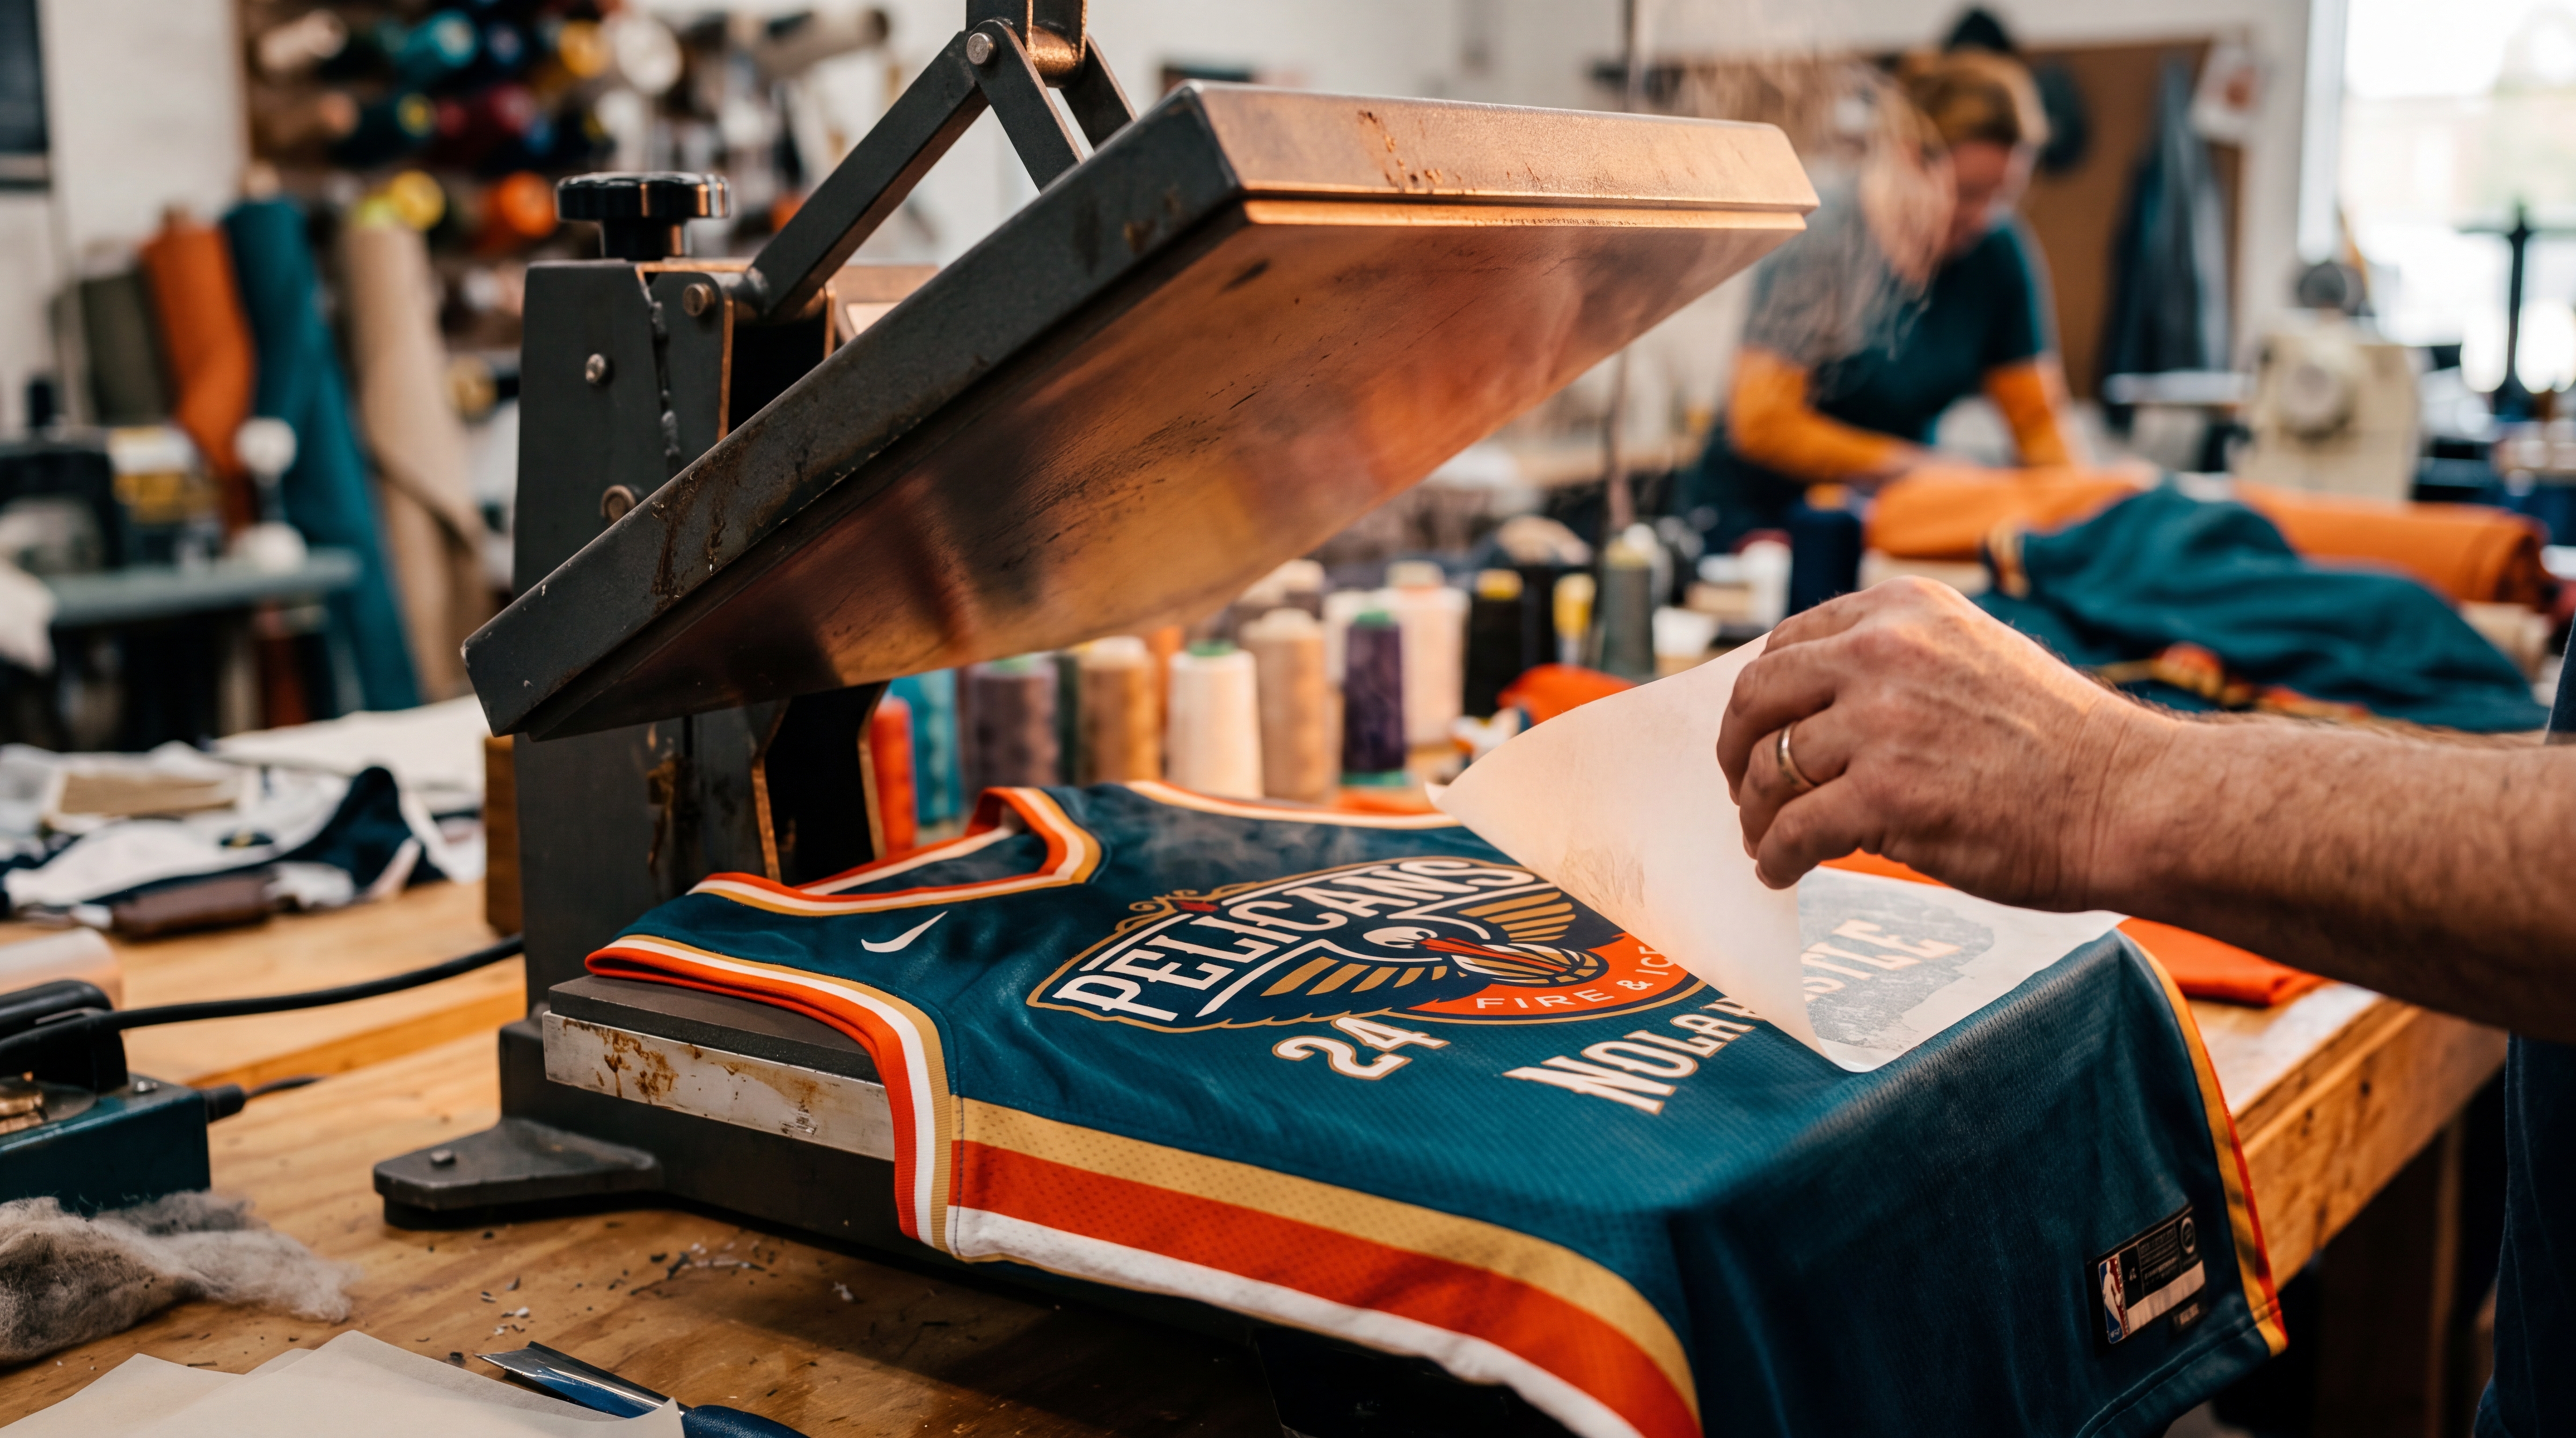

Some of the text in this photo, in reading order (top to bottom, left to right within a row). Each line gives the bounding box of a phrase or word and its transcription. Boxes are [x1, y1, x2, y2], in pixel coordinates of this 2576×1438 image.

[1052, 860, 1535, 1021] PELICANS
[1476, 989, 1615, 1009] FIRE
[1616, 980, 1654, 990] &
[1272, 1016, 1450, 1080] 24
